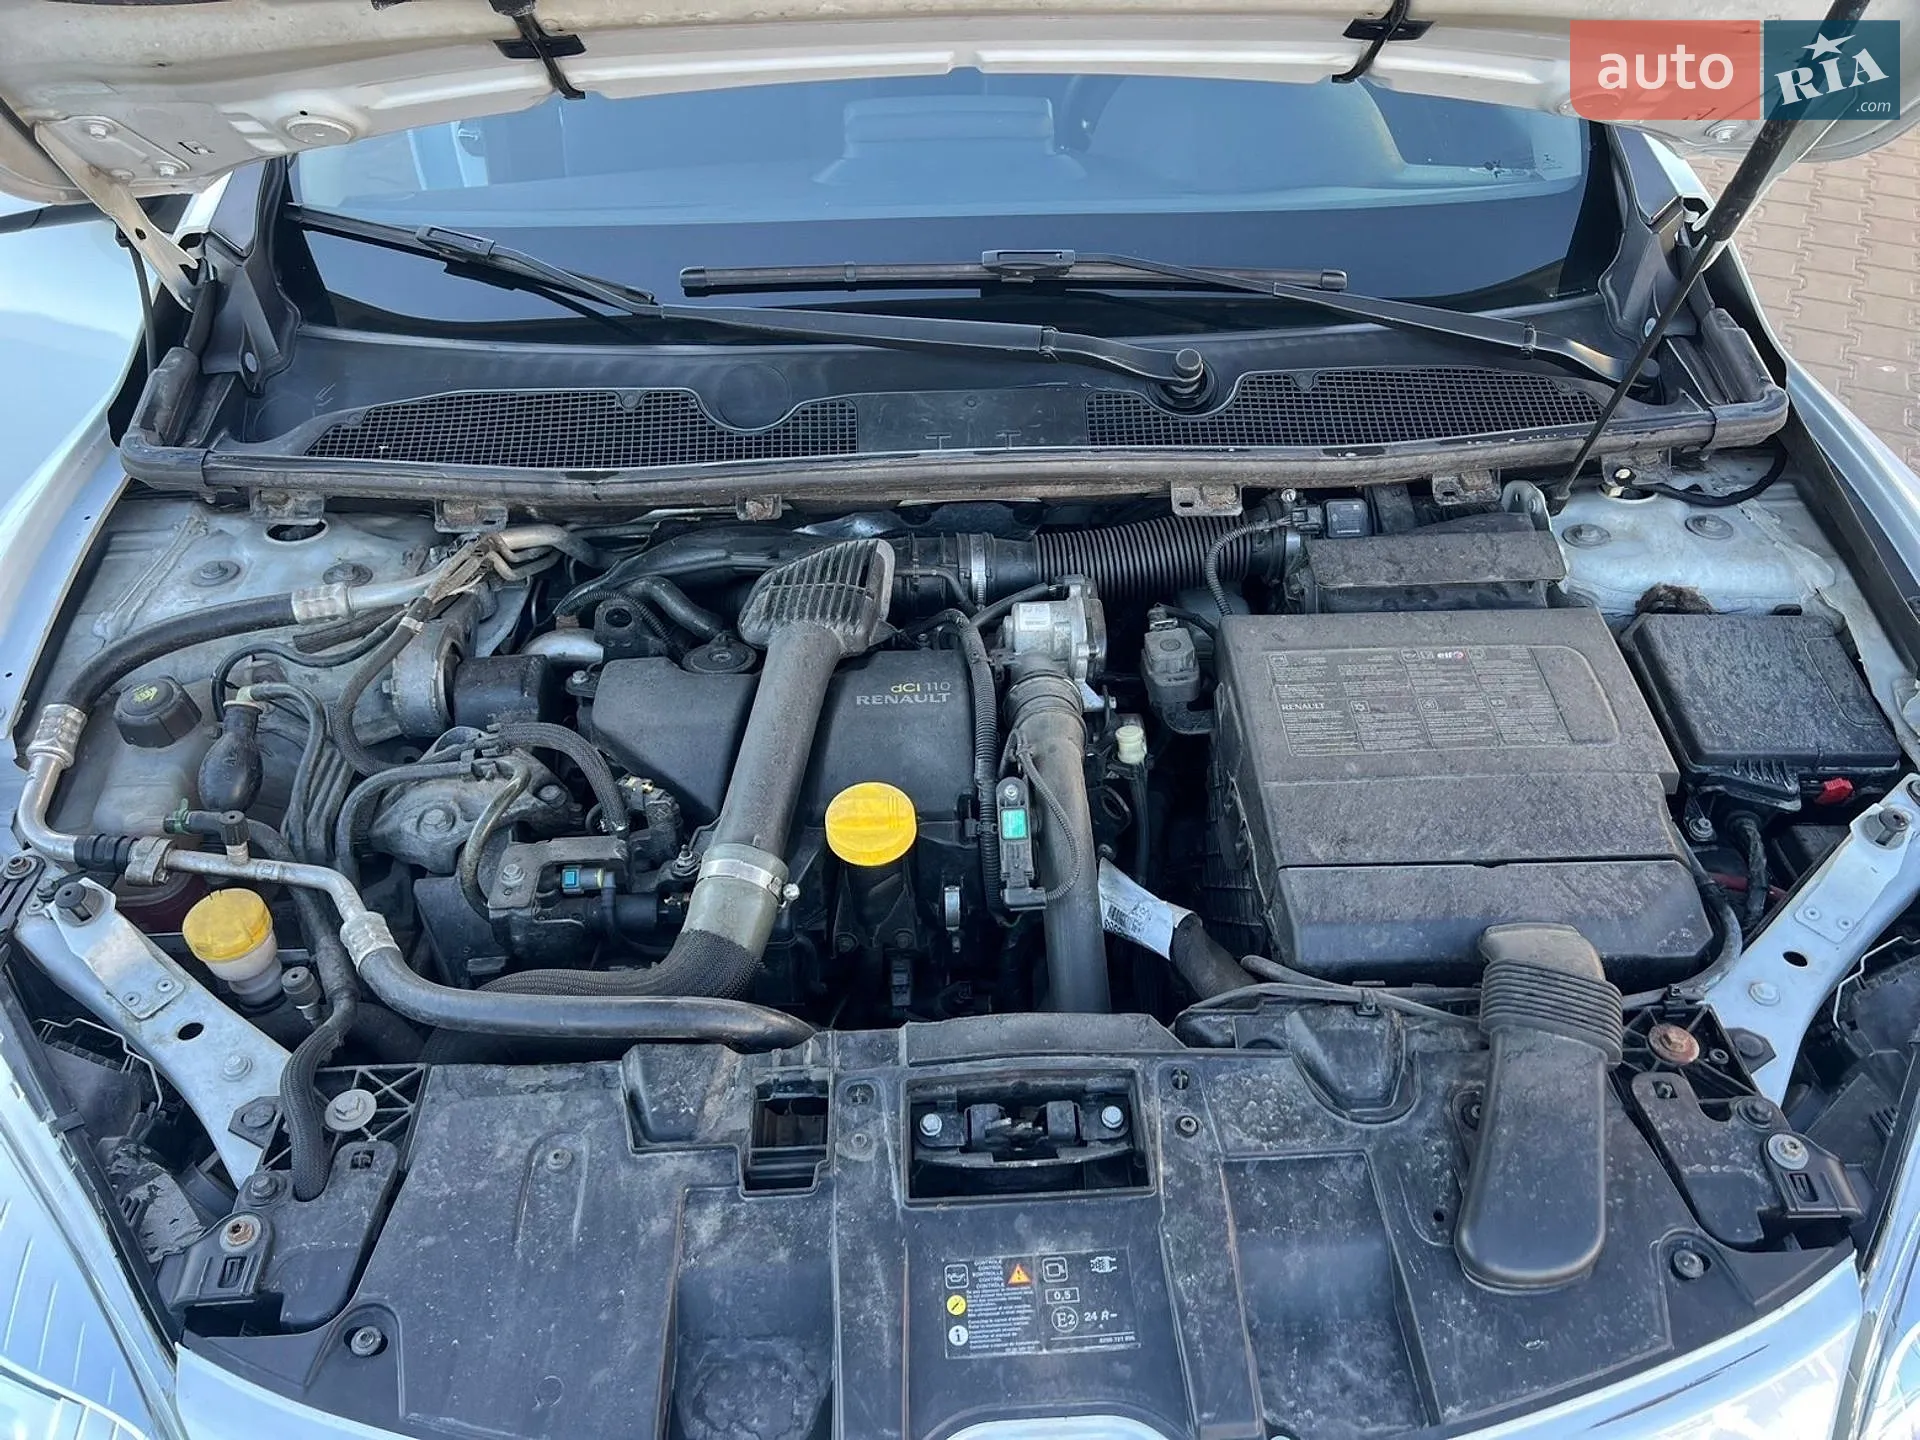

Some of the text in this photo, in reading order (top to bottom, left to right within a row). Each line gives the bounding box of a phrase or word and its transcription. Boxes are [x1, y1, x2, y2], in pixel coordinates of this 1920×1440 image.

[1437, 651, 1452, 659] elf
[924, 681, 951, 692] 110
[856, 692, 951, 705] RENAULT
[1281, 702, 1325, 710] RENAULT
[1056, 1311, 1076, 1328] E2
[1084, 1310, 1098, 1322] 24
